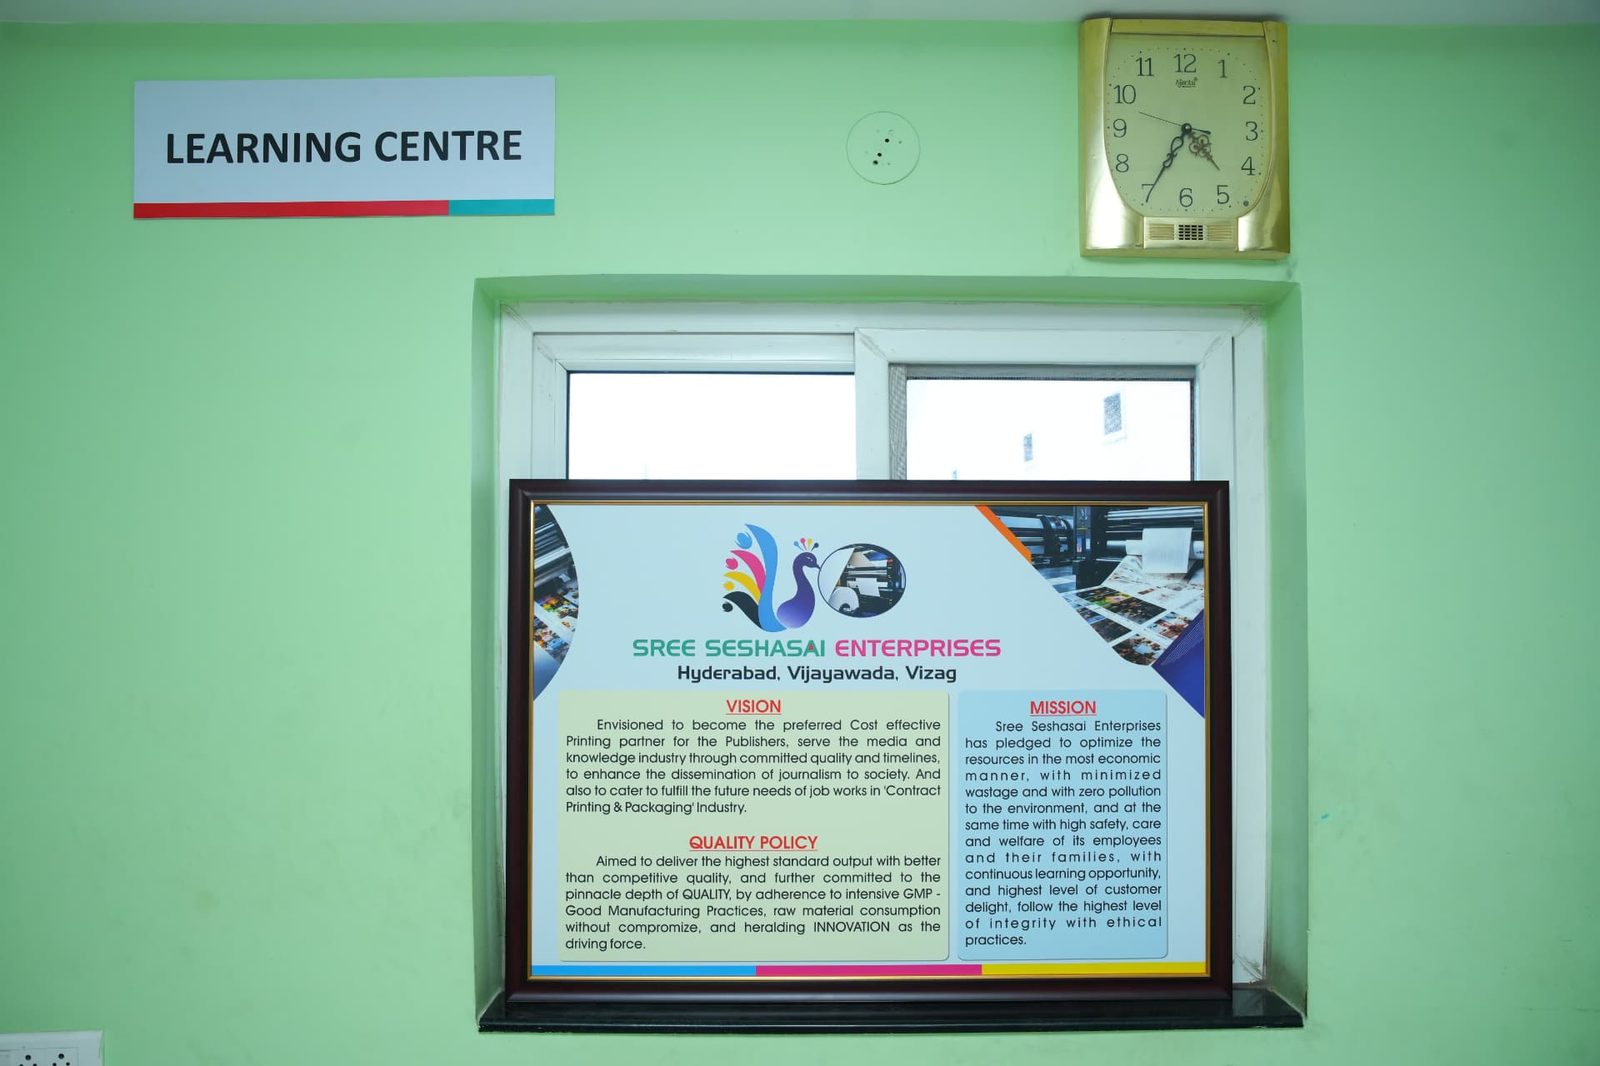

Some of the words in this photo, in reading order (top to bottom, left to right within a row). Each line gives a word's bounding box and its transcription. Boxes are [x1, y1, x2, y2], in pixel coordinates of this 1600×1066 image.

[1136, 57, 1154, 77] 11
[1174, 53, 1197, 73] 12
[1217, 59, 1228, 78] 1
[1113, 84, 1136, 105] 10
[1243, 85, 1256, 105] 2
[1113, 118, 1127, 138] 9
[1245, 121, 1258, 141] 3
[167, 132, 360, 163] LEARNING
[375, 131, 521, 162] CENTRE
[1115, 154, 1129, 173] 8
[1241, 156, 1255, 176] 4
[1141, 183, 1155, 203] 7
[1179, 188, 1193, 207] 6
[1217, 185, 1230, 204] 5
[632, 638, 696, 657] SREE
[705, 639, 826, 658] SESHASAI
[834, 638, 1002, 658] ENTERPRISES
[677, 664, 781, 684] Hyderabad,
[786, 665, 899, 684] Vijayawada,
[904, 664, 957, 684] Vizag
[725, 698, 782, 713] VISION
[1029, 699, 1097, 714] MISSION
[596, 718, 664, 731] Envisioned
[671, 719, 685, 731] to
[692, 719, 747, 731] become
[754, 719, 776, 731] the
[782, 719, 842, 733] preferred
[849, 718, 879, 731] Cost
[885, 718, 941, 731] effective
[995, 720, 1024, 733] Sree
[1031, 720, 1087, 732] Seshasai
[1094, 719, 1162, 734] Enterprises
[566, 735, 612, 750] Printing
[619, 735, 666, 750] partner
[672, 735, 690, 748] for
[696, 735, 718, 748] the
[725, 735, 790, 749] Publishers,
[797, 737, 831, 748] serve
[838, 735, 859, 748] the
[866, 735, 908, 748] media
[914, 735, 941, 747] and
[965, 737, 988, 749] has
[995, 736, 1052, 752] pledged
[1059, 736, 1073, 749] to
[1079, 736, 1134, 751] optimize
[1140, 736, 1162, 748] the
[566, 751, 637, 767] knowledge
[638, 752, 687, 766] industry
[688, 752, 737, 767] through
[739, 752, 808, 764] committed
[809, 752, 853, 766] quality
[854, 752, 881, 764] and
[882, 752, 941, 765] timelines,
[965, 755, 1025, 766] resources
[1027, 753, 1039, 765] in
[1041, 753, 1063, 765] the
[1065, 752, 1095, 765] most
[1097, 752, 1161, 765] economic
[565, 767, 579, 780] to
[583, 768, 641, 780] enhance
[645, 768, 667, 780] the
[670, 768, 757, 781] dissemination
[761, 768, 775, 781] of
[777, 768, 842, 783] journalism
[846, 768, 860, 780] to
[863, 768, 911, 782] society.
[914, 767, 941, 780] And
[965, 771, 1030, 783] manner,
[1039, 769, 1071, 781] with
[1080, 768, 1162, 781] minimized
[964, 786, 1019, 801] wastage
[1021, 786, 1048, 798] and
[1050, 785, 1076, 798] with
[1078, 787, 1106, 797] zero
[1108, 785, 1162, 799] pollution
[565, 801, 611, 816] Printing
[613, 801, 624, 813] &
[624, 801, 695, 816] Packaging'
[696, 801, 747, 816] Industry.
[688, 835, 756, 849] QUALITY
[759, 835, 819, 849] POLICY
[964, 835, 991, 848] and
[998, 835, 1046, 847] welfare
[1052, 834, 1065, 847] of
[1072, 834, 1086, 847] its
[1092, 834, 1162, 849] employees
[595, 855, 637, 867] Aimed
[639, 855, 653, 867] to
[655, 855, 699, 867] deliver
[701, 855, 722, 867] the
[724, 855, 770, 870] highest
[772, 855, 830, 867] standard
[832, 855, 874, 869] output
[875, 855, 901, 867] with
[903, 854, 942, 867] better
[964, 851, 996, 864] and
[1004, 851, 1042, 864] their
[1051, 850, 1120, 864] families,
[1130, 850, 1162, 862] with
[565, 871, 595, 884] than
[602, 872, 679, 886] competitive
[685, 871, 732, 887] quality,
[740, 872, 767, 884] and
[774, 872, 816, 884] further
[822, 871, 893, 884] committed
[899, 871, 913, 883] to
[920, 871, 941, 883] the
[964, 867, 1033, 880] continuous
[1034, 867, 1086, 882] learning
[1087, 866, 1161, 881] opportunity,
[565, 887, 622, 902] pinnacle
[624, 888, 663, 903] depth
[665, 888, 680, 901] of
[681, 888, 732, 901] QUALITY,
[735, 888, 753, 903] by
[755, 888, 827, 901] adherence
[829, 888, 843, 900] to
[845, 887, 901, 900] intensive
[902, 887, 933, 900] GMP
[964, 884, 991, 897] and
[997, 884, 1043, 899] highest
[1049, 883, 1079, 896] level
[1085, 883, 1099, 896] of
[1104, 883, 1162, 896] customer
[565, 904, 602, 917] Good
[608, 904, 701, 920] Manufacturing
[706, 904, 767, 918] Practices,
[773, 906, 797, 917] raw
[802, 904, 854, 917] material
[859, 904, 941, 918] consumption
[964, 901, 1012, 916] delight,
[1016, 900, 1054, 913] follow
[1058, 900, 1079, 913] the
[1083, 899, 1128, 915] highest
[1132, 899, 1162, 912] level
[565, 921, 611, 933] without
[617, 921, 702, 936] compromize,
[709, 921, 736, 933] and
[744, 921, 806, 936] heralding
[813, 920, 890, 933] INNOVATION
[897, 922, 913, 933] as
[920, 920, 941, 933] the
[964, 917, 980, 930] of
[989, 916, 1057, 932] integrity
[1065, 916, 1097, 929] with
[1106, 915, 1162, 928] ethical
[565, 937, 608, 953] driving
[609, 937, 646, 950] force.
[965, 933, 1027, 948] practices.
